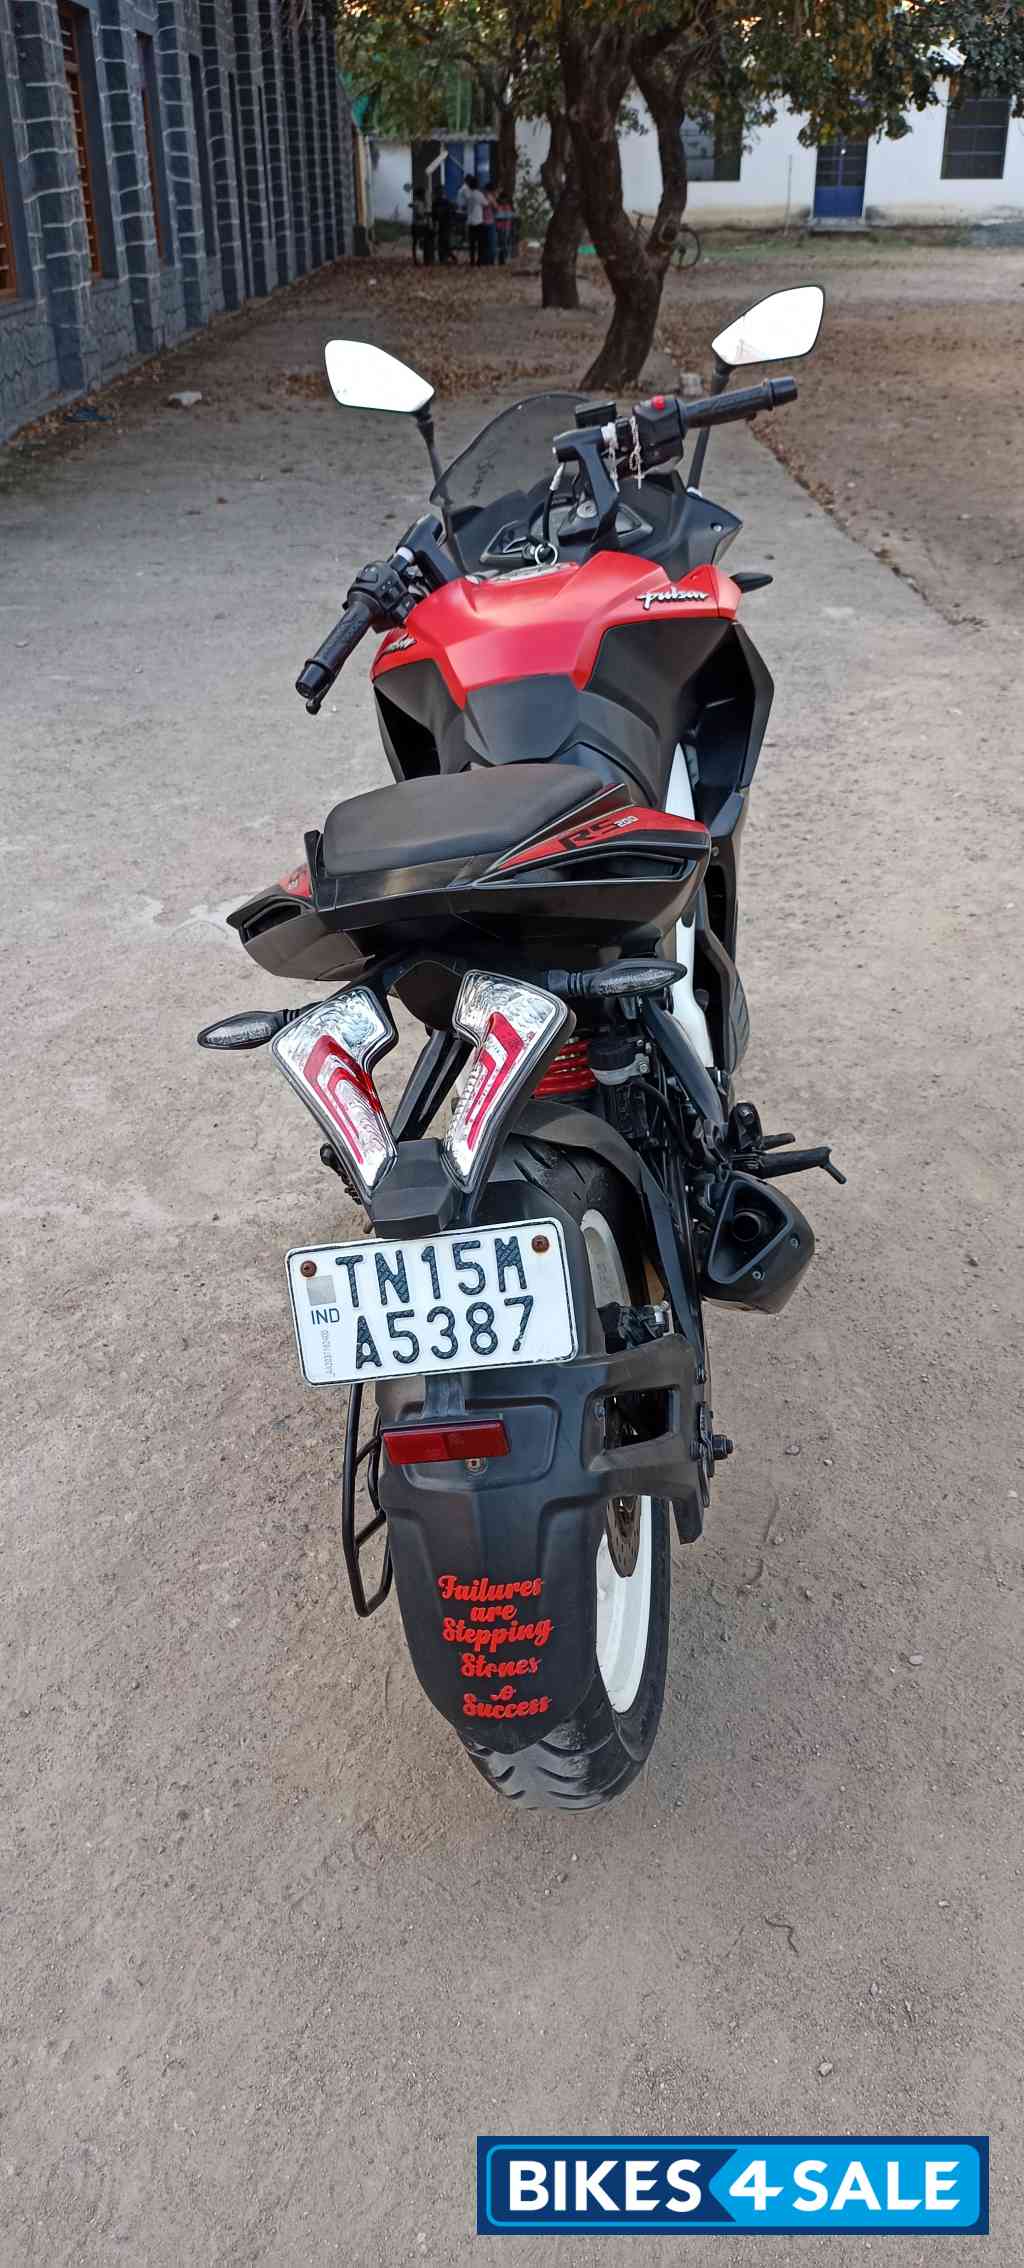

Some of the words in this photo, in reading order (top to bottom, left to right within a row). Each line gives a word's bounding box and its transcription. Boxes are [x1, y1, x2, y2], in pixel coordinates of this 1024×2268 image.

[335, 1236, 528, 1308] TN15M
[311, 1308, 340, 1325] IND
[355, 1295, 534, 1369] A5387
[438, 1575, 544, 1602] Failures
[470, 1604, 518, 1622] are
[443, 1617, 554, 1653] Stepping
[463, 1692, 552, 1720] Success
